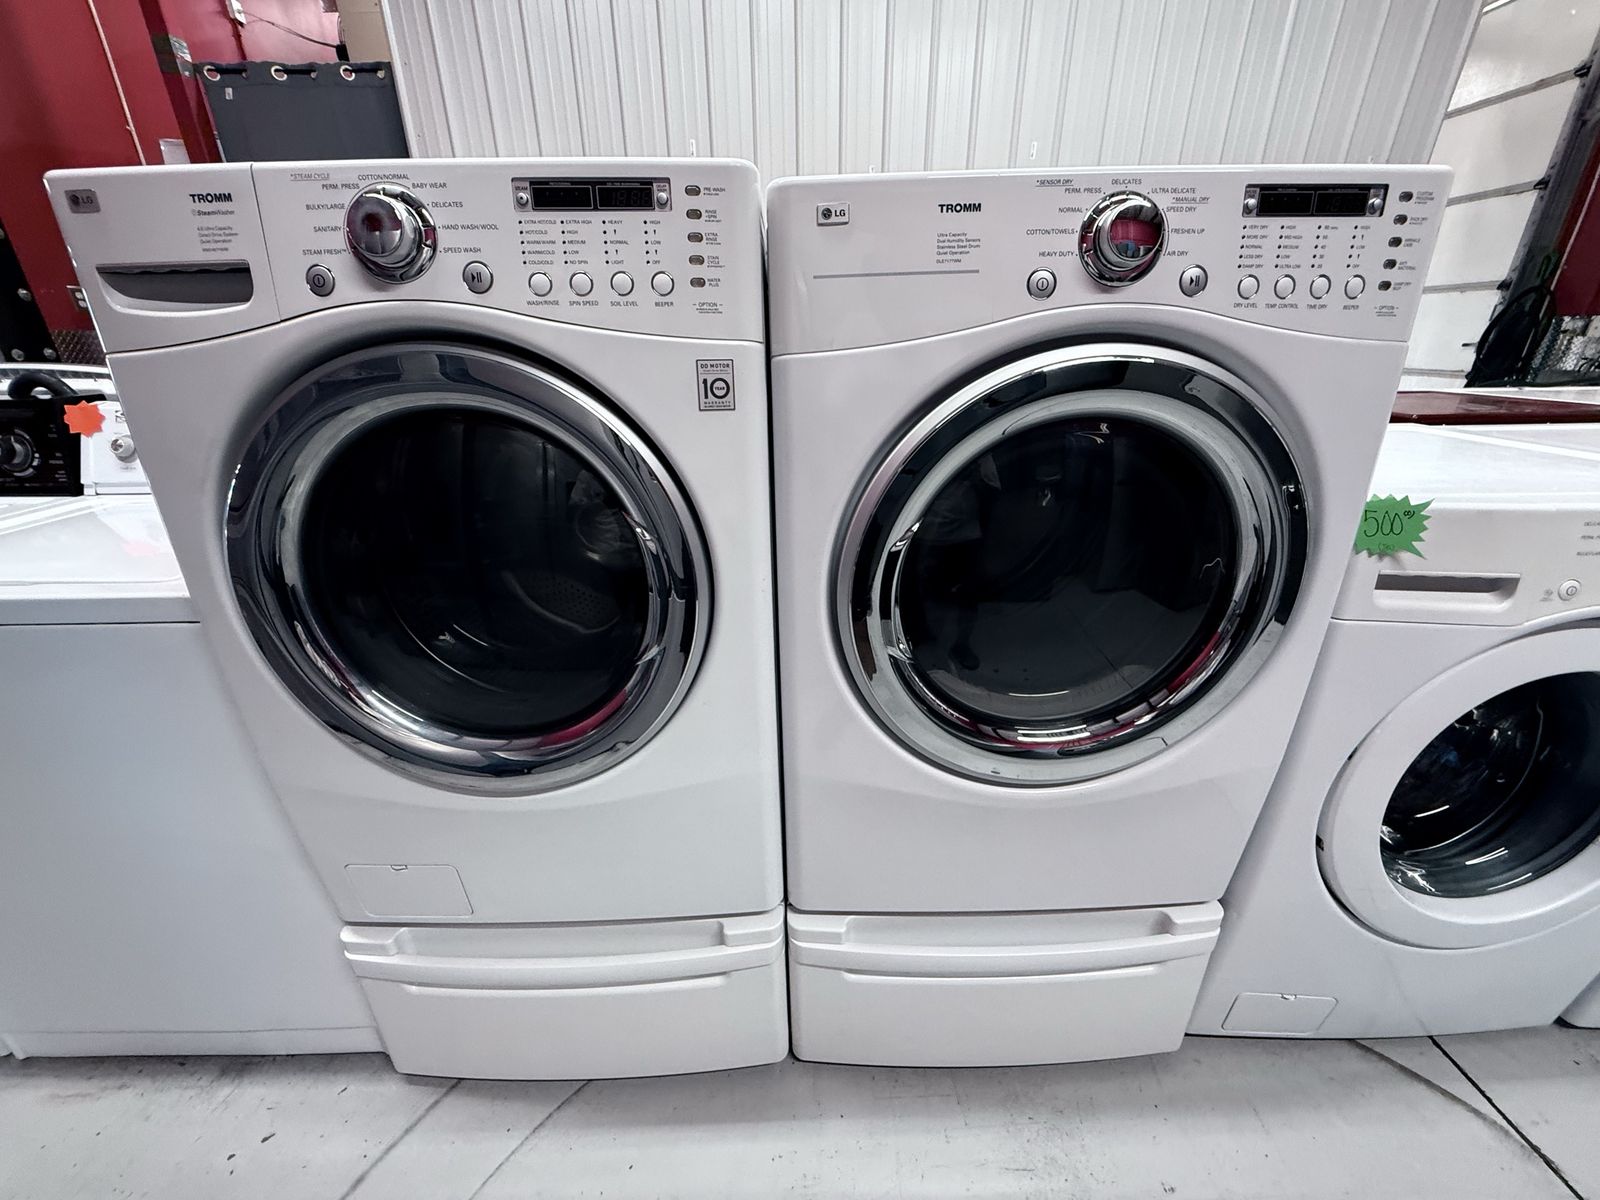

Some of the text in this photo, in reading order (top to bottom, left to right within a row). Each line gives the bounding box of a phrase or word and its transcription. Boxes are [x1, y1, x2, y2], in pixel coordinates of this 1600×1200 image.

[189, 193, 232, 203] TROMM
[834, 209, 846, 217] LG
[938, 203, 981, 213] TROMM
[702, 378, 730, 399] 10
